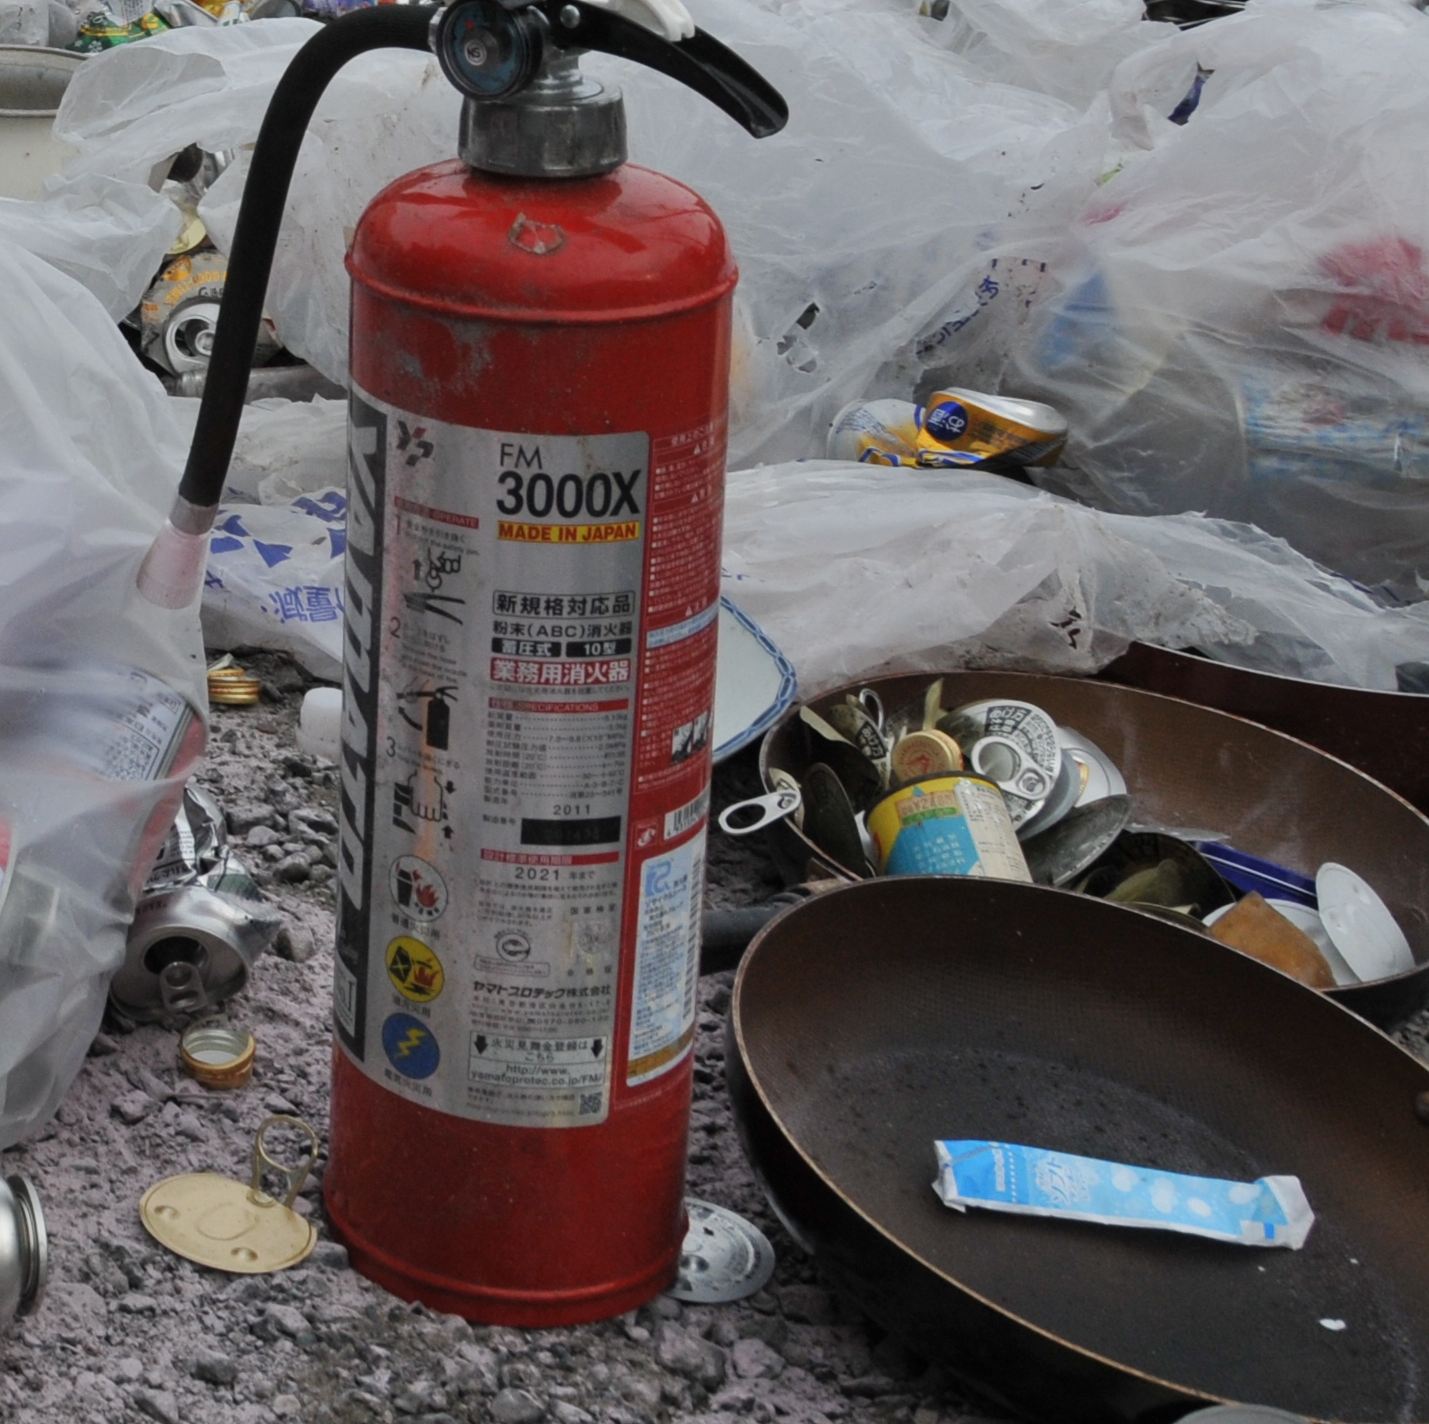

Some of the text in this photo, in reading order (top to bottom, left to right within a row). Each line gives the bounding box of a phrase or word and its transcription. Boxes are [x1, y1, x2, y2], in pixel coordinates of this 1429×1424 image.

[499, 442, 543, 470] FM
[496, 470, 641, 518] 3000X
[499, 522, 637, 542] MADE IN JAPAN
[496, 594, 631, 616] 新規格対応品
[390, 616, 401, 639] 2
[493, 620, 633, 638] 粉末(ABC)消火器
[502, 639, 617, 657] 蓄圧式 10型
[493, 659, 630, 685] 業務用消火器
[386, 736, 397, 757] 3
[552, 804, 591, 815] 2011
[514, 867, 560, 881] 2021
